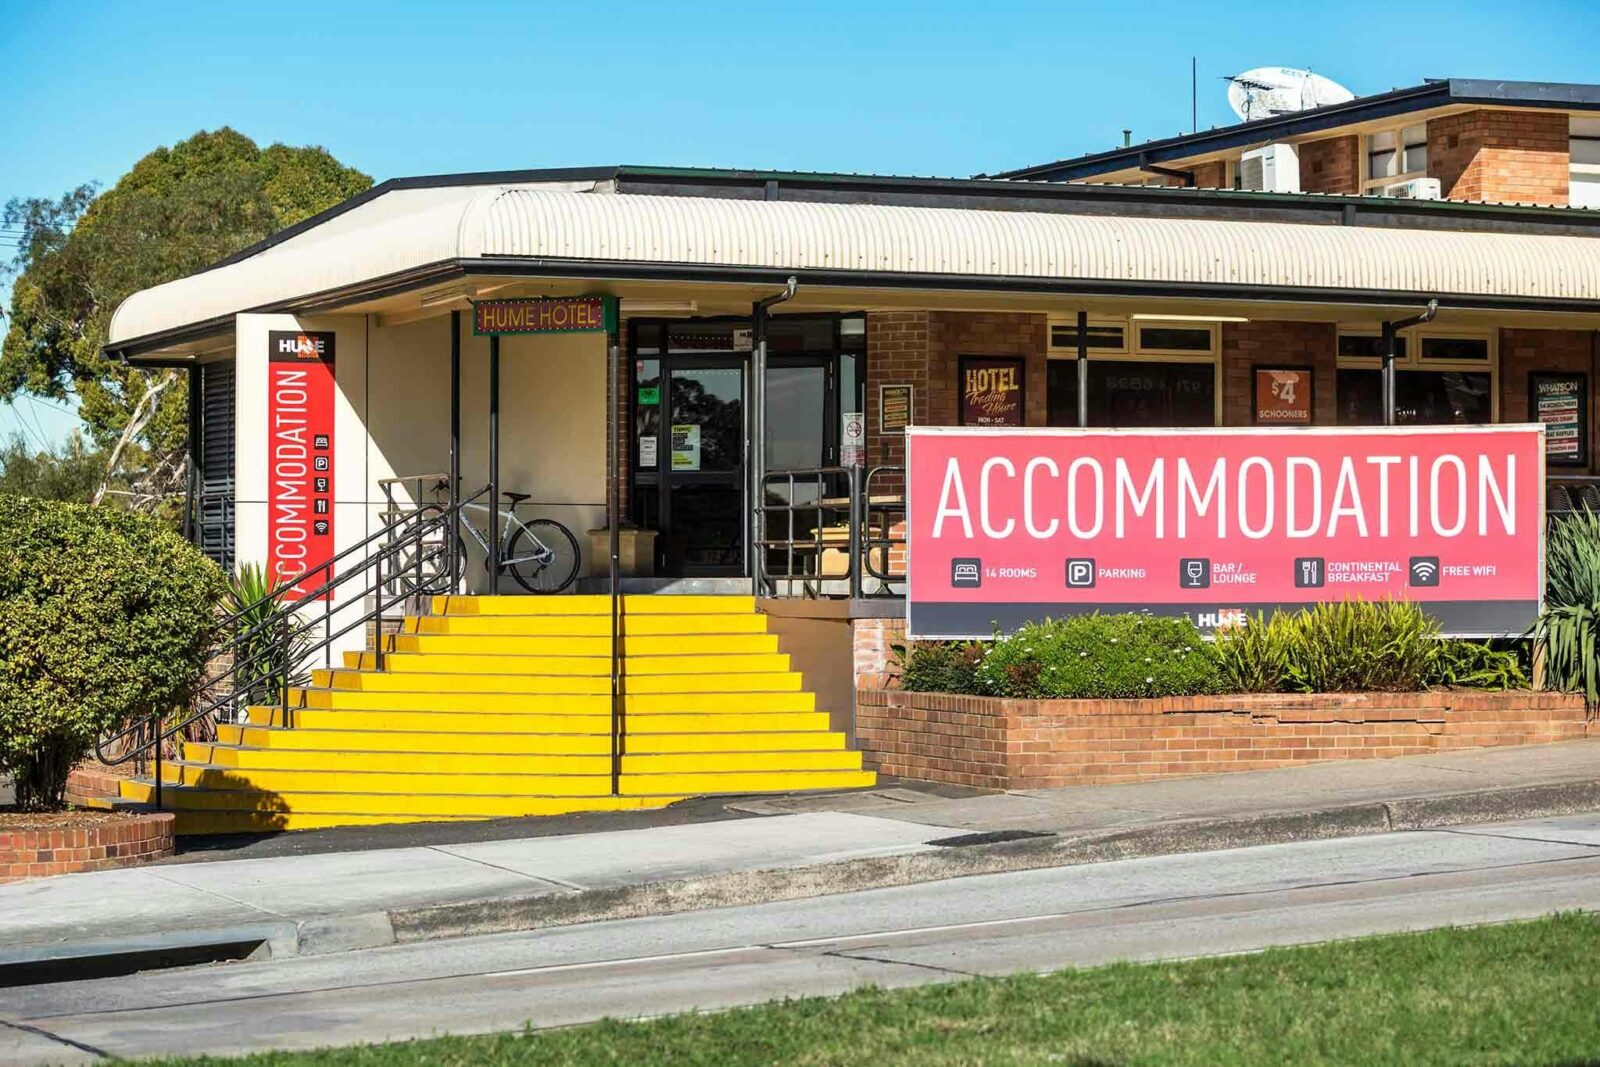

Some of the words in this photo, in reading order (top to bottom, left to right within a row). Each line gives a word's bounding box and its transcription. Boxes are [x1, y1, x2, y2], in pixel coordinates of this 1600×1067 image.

[483, 305, 535, 329] HUME
[539, 302, 596, 326] HOTEL
[965, 367, 1020, 393] HOTEL
[1271, 380, 1297, 405] $4
[965, 391, 1007, 406] Trading
[983, 402, 1017, 415] Hours
[1259, 409, 1308, 420] SCHOONERS
[933, 454, 1518, 540] ACCOMMODATION
[1213, 563, 1235, 573] BAR
[1327, 562, 1402, 572] CONTINENTAL
[1442, 566, 1470, 577] FREE
[1472, 565, 1496, 576] WIFI
[985, 568, 997, 578] 14
[999, 568, 1037, 579] ROOMS
[1098, 568, 1146, 579] PARKING
[1213, 573, 1257, 584] LOUNGE
[1327, 572, 1390, 583] BREAKFAST
